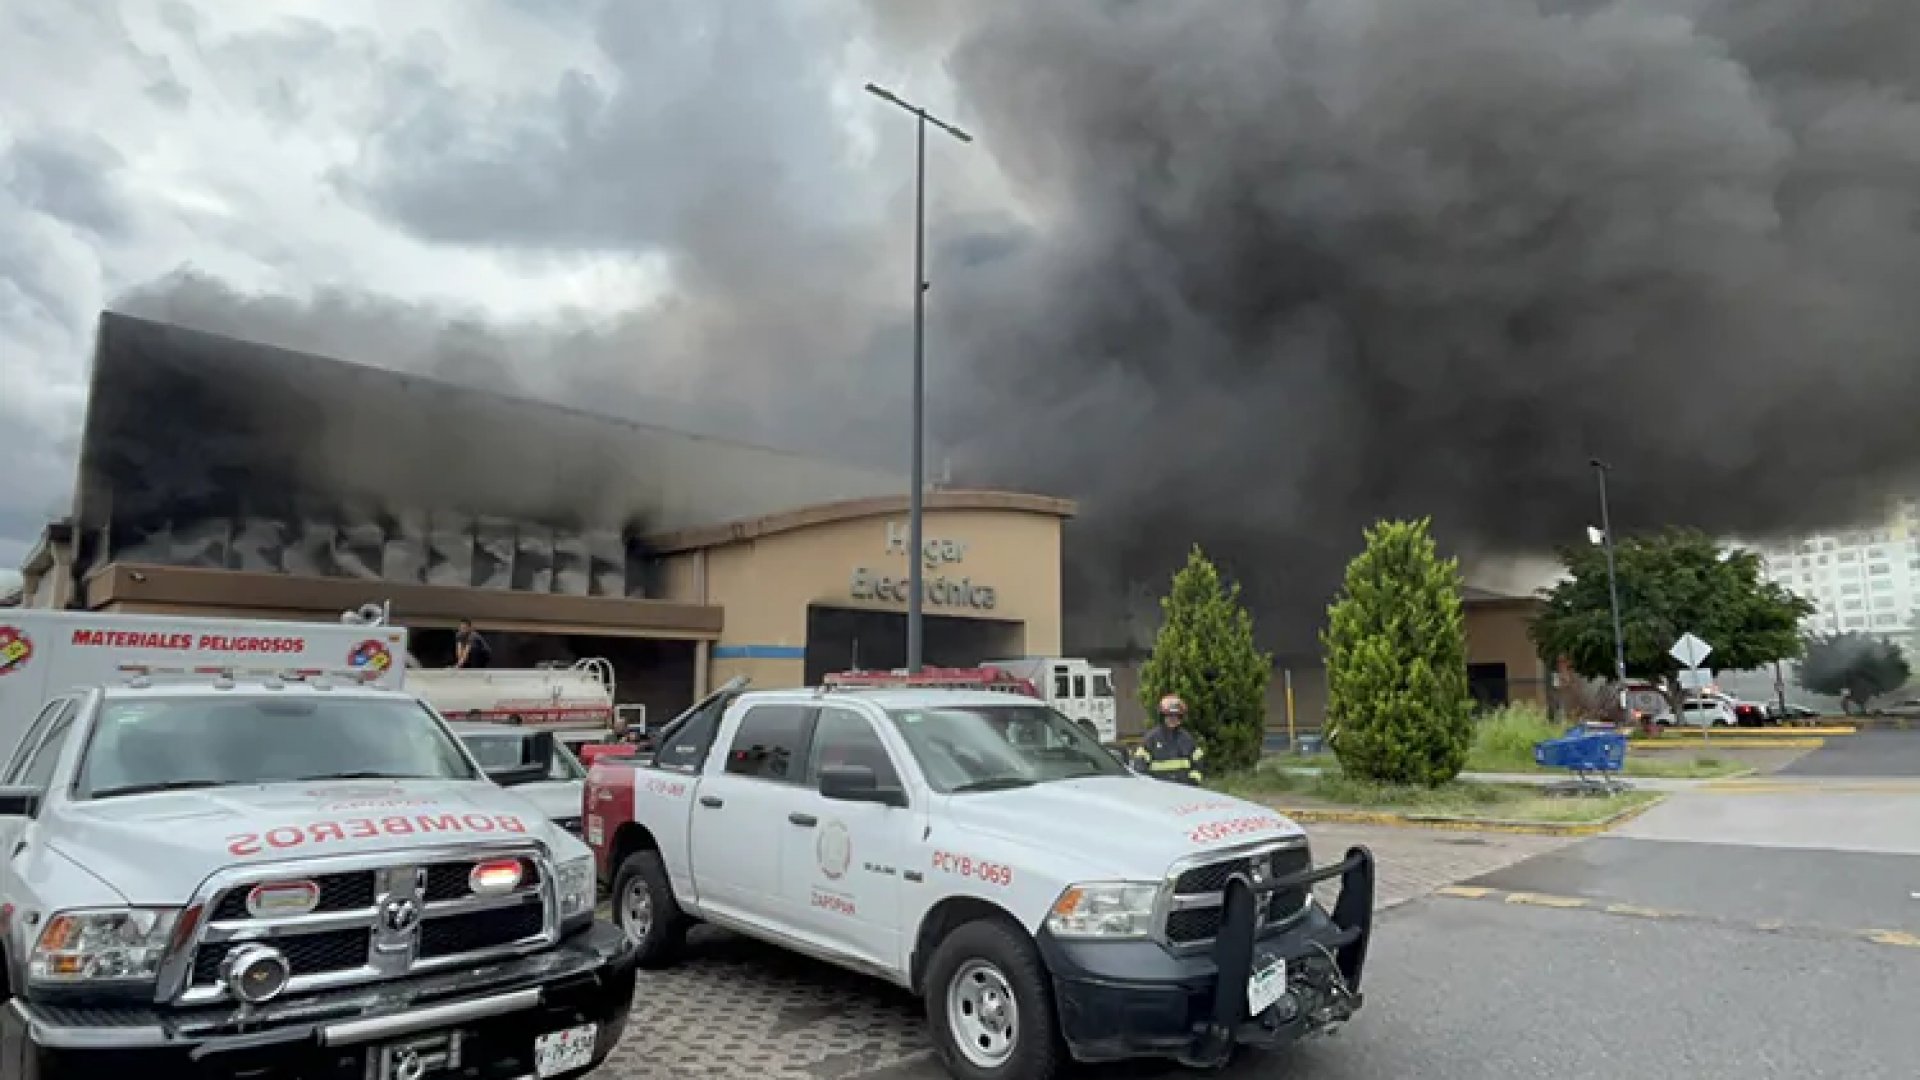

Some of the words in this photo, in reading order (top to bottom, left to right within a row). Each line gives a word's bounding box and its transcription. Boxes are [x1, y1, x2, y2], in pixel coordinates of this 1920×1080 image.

[885, 521, 967, 568] Hgar
[72, 629, 193, 649] MATERIALES
[199, 634, 305, 653] PELIGROSOS
[932, 851, 1012, 886] PCYB-069
